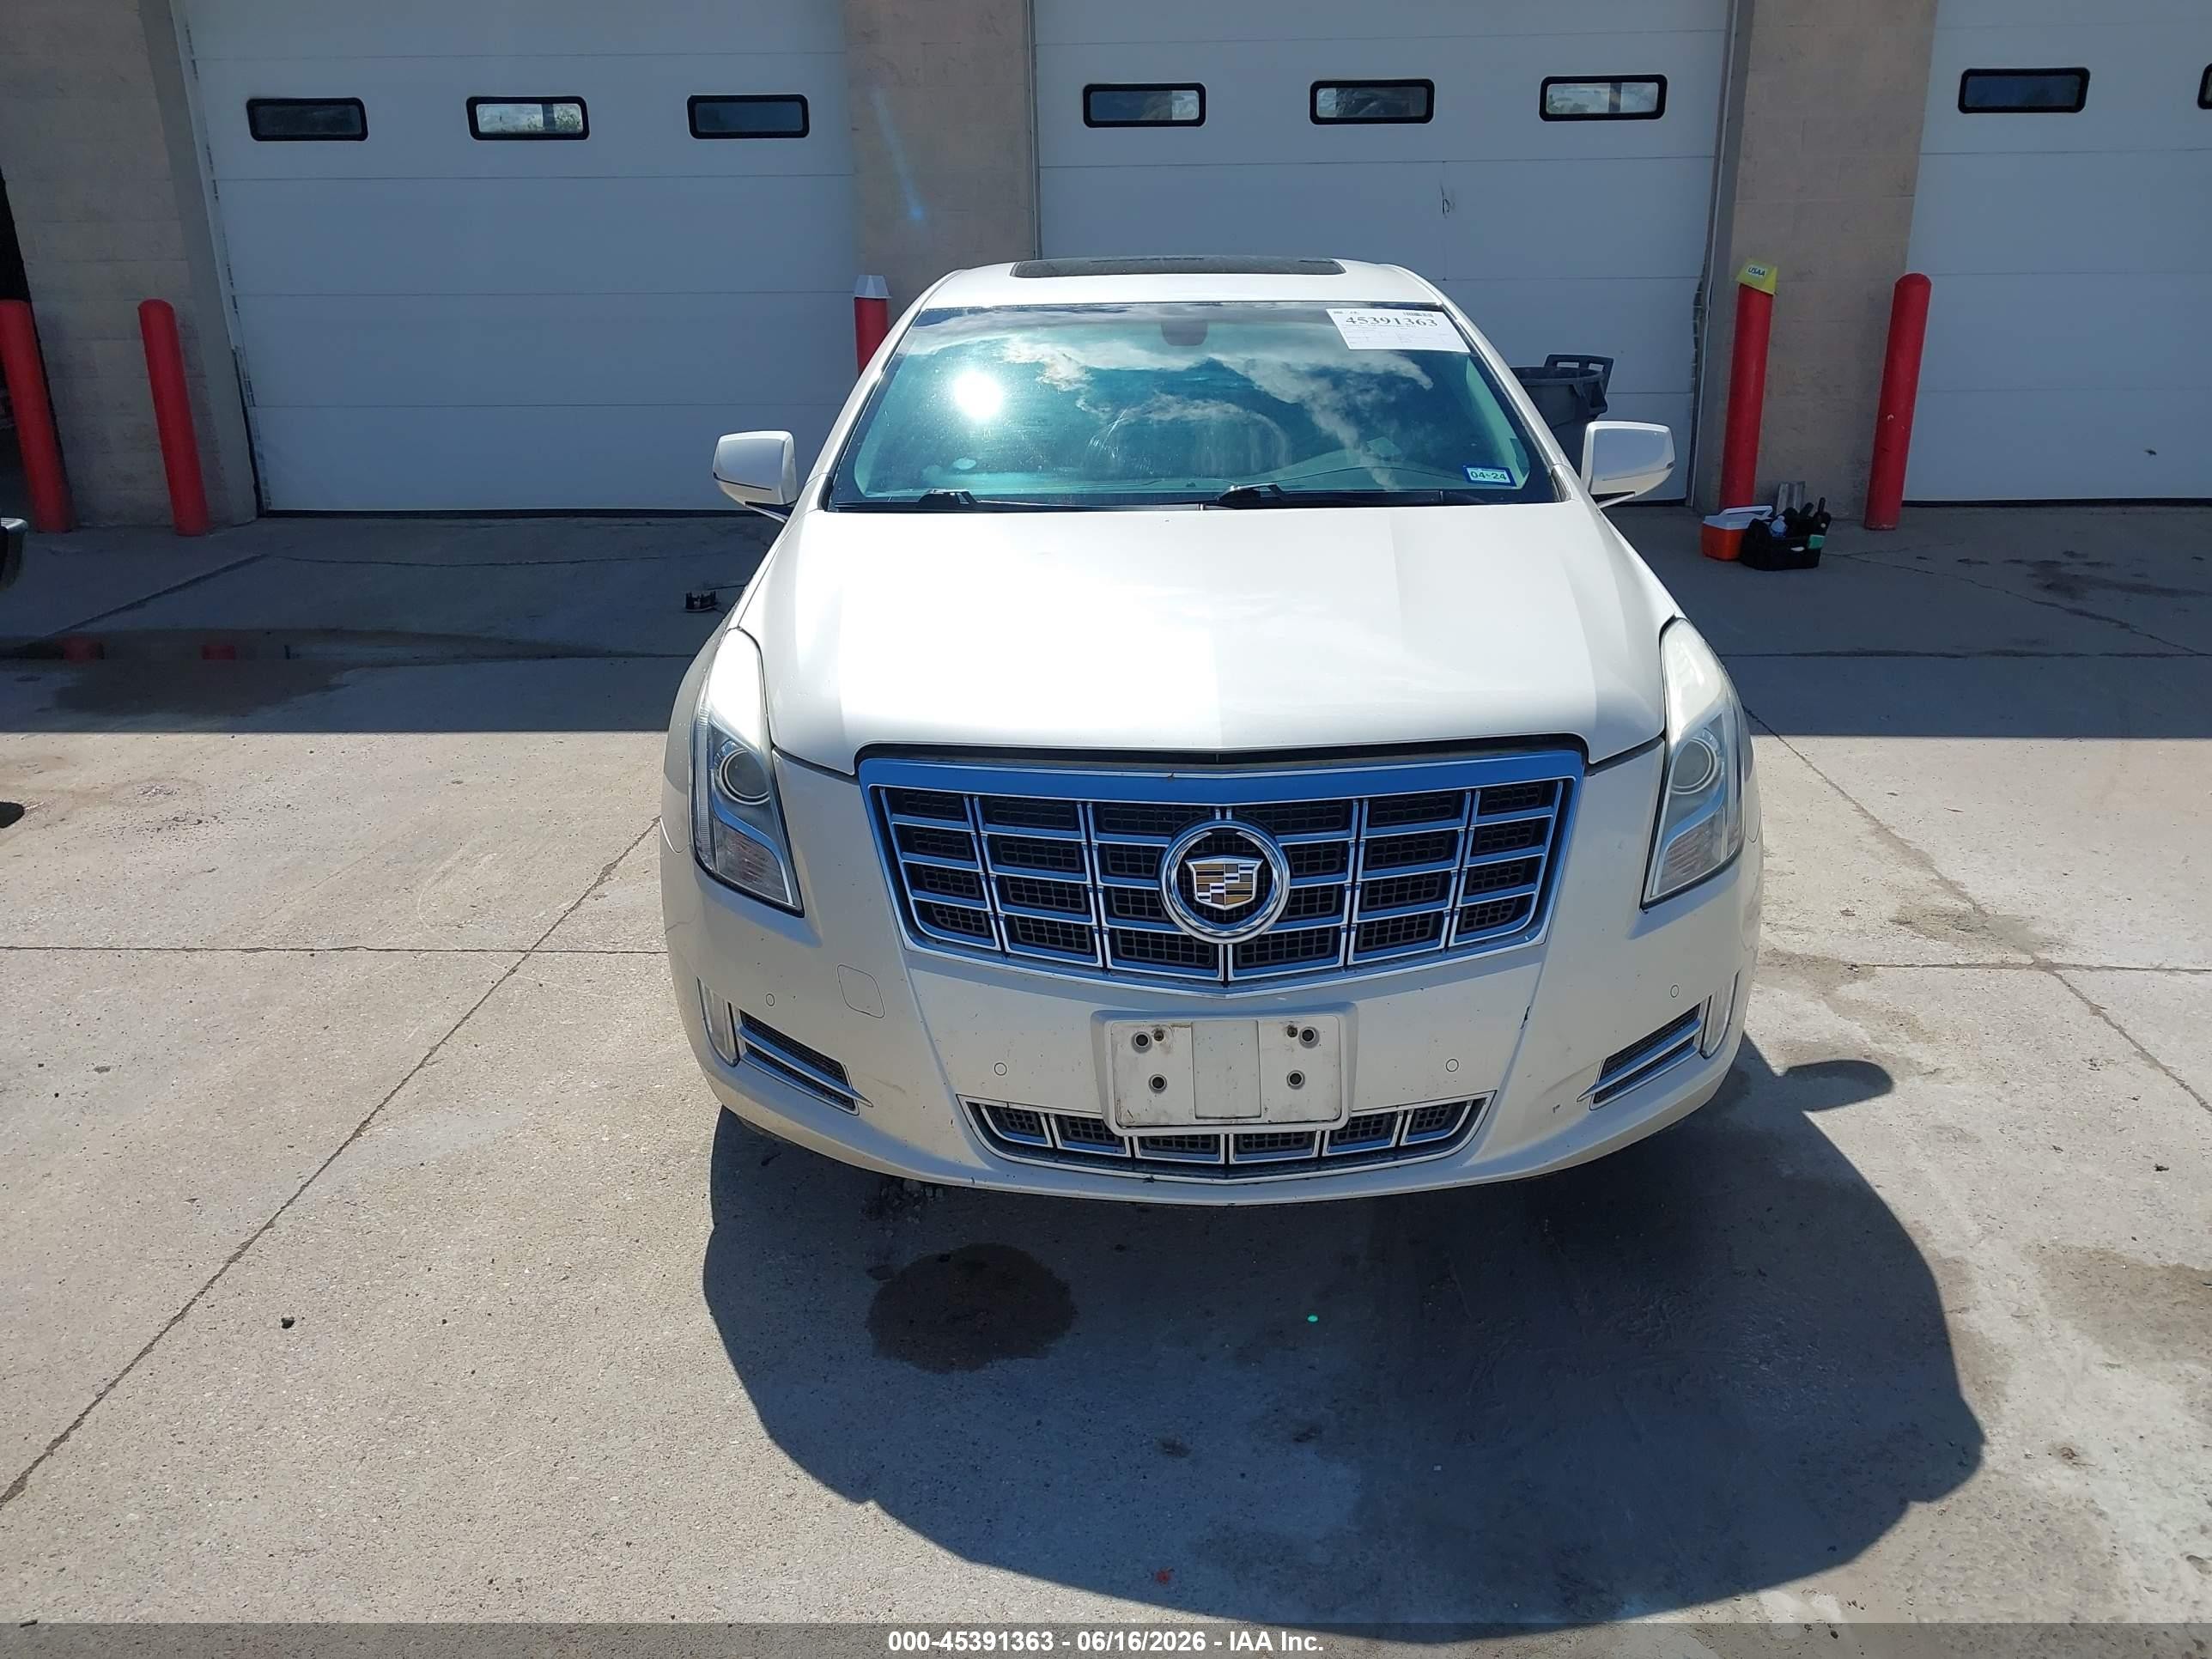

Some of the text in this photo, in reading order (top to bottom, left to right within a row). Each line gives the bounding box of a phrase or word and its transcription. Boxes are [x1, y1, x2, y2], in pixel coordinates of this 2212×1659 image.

[1747, 267, 1765, 276] USAA
[1346, 316, 1437, 327] 45391363
[1470, 471, 1507, 481] 04-24
